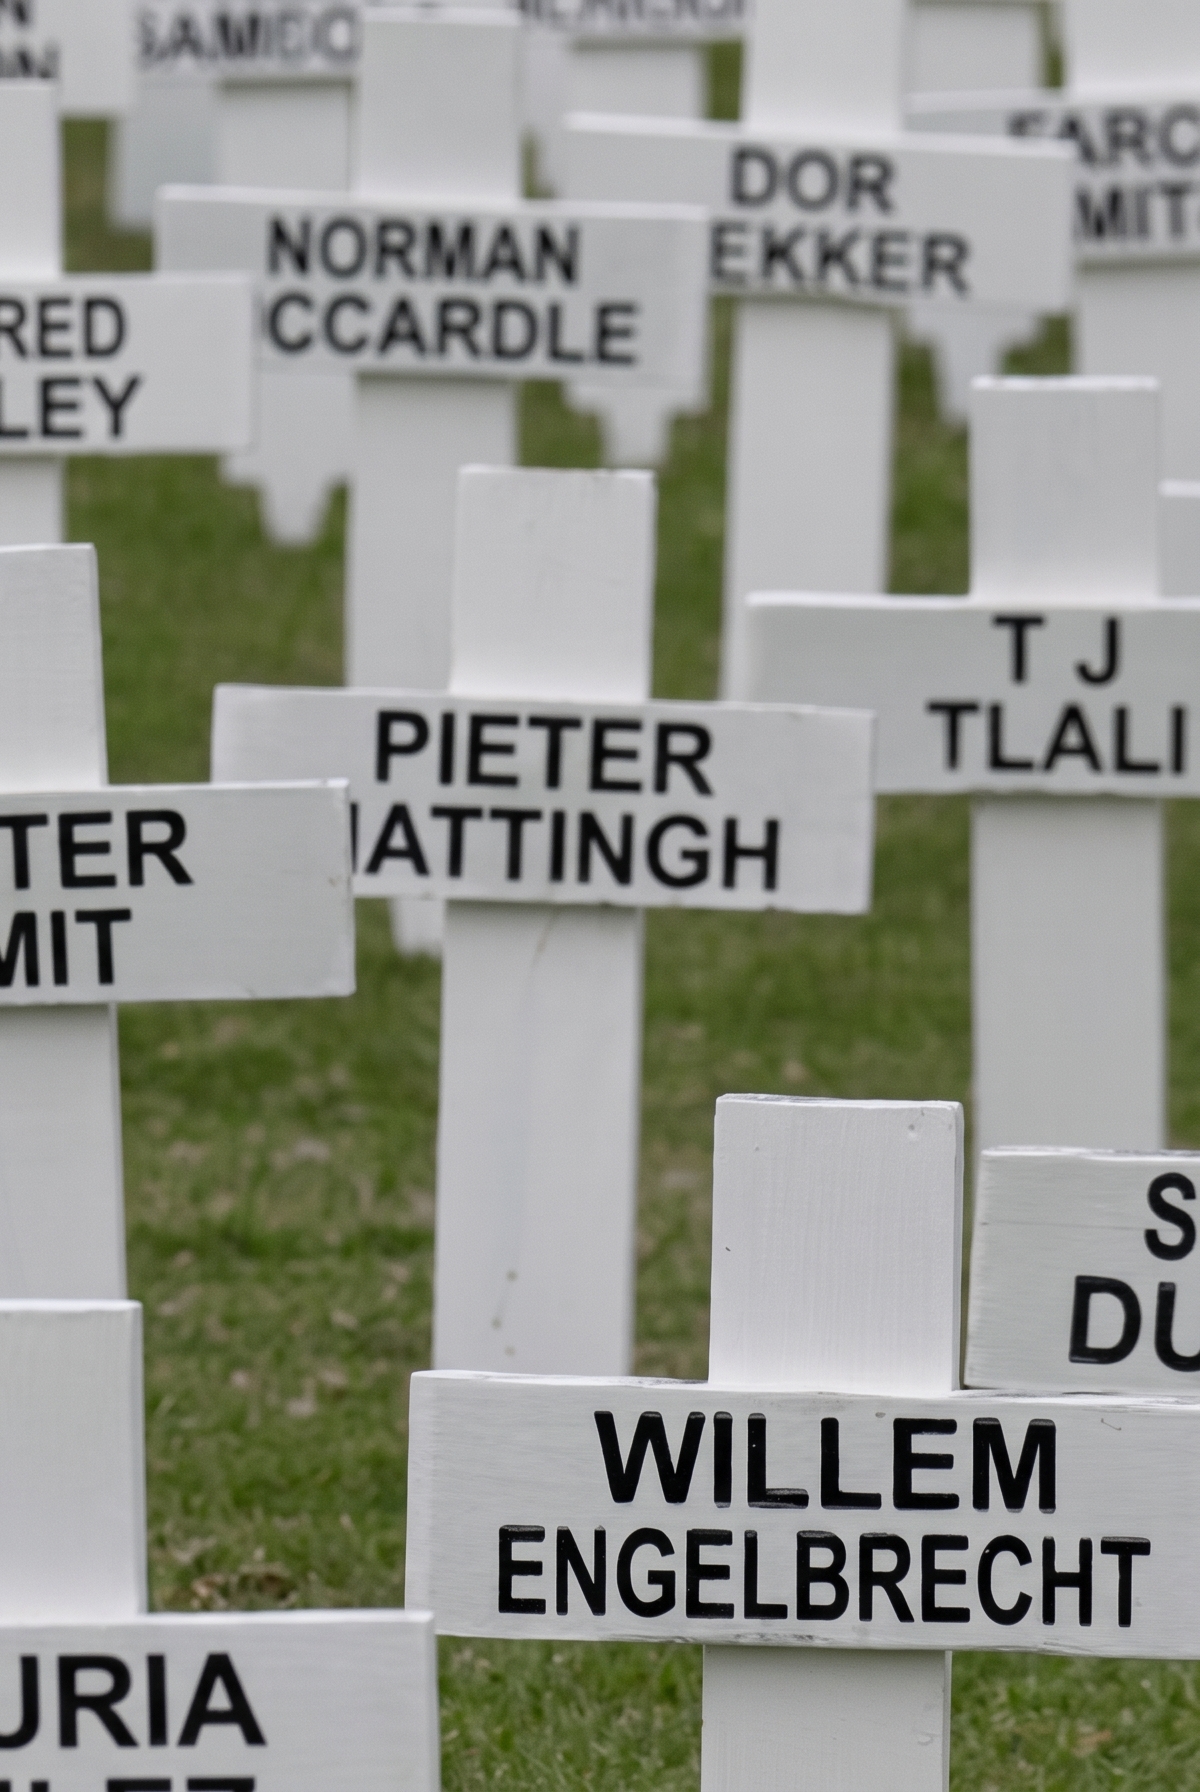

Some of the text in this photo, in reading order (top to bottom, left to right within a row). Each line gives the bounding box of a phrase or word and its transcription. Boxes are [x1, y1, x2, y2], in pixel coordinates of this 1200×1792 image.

[730, 145, 895, 214] DOR
[1074, 182, 1200, 242] MIT
[269, 217, 578, 285] NORMAN
[710, 220, 970, 297] EKKER
[262, 291, 636, 366] CCARDLE
[993, 615, 1120, 686] T J
[376, 710, 712, 796] PIETER
[927, 701, 1186, 775] TLALI
[350, 802, 779, 891] ATTINGH
[1144, 1172, 1196, 1261] S
[594, 1411, 1056, 1513] WILLEM
[498, 1525, 1151, 1627] ENGELBRECHT
